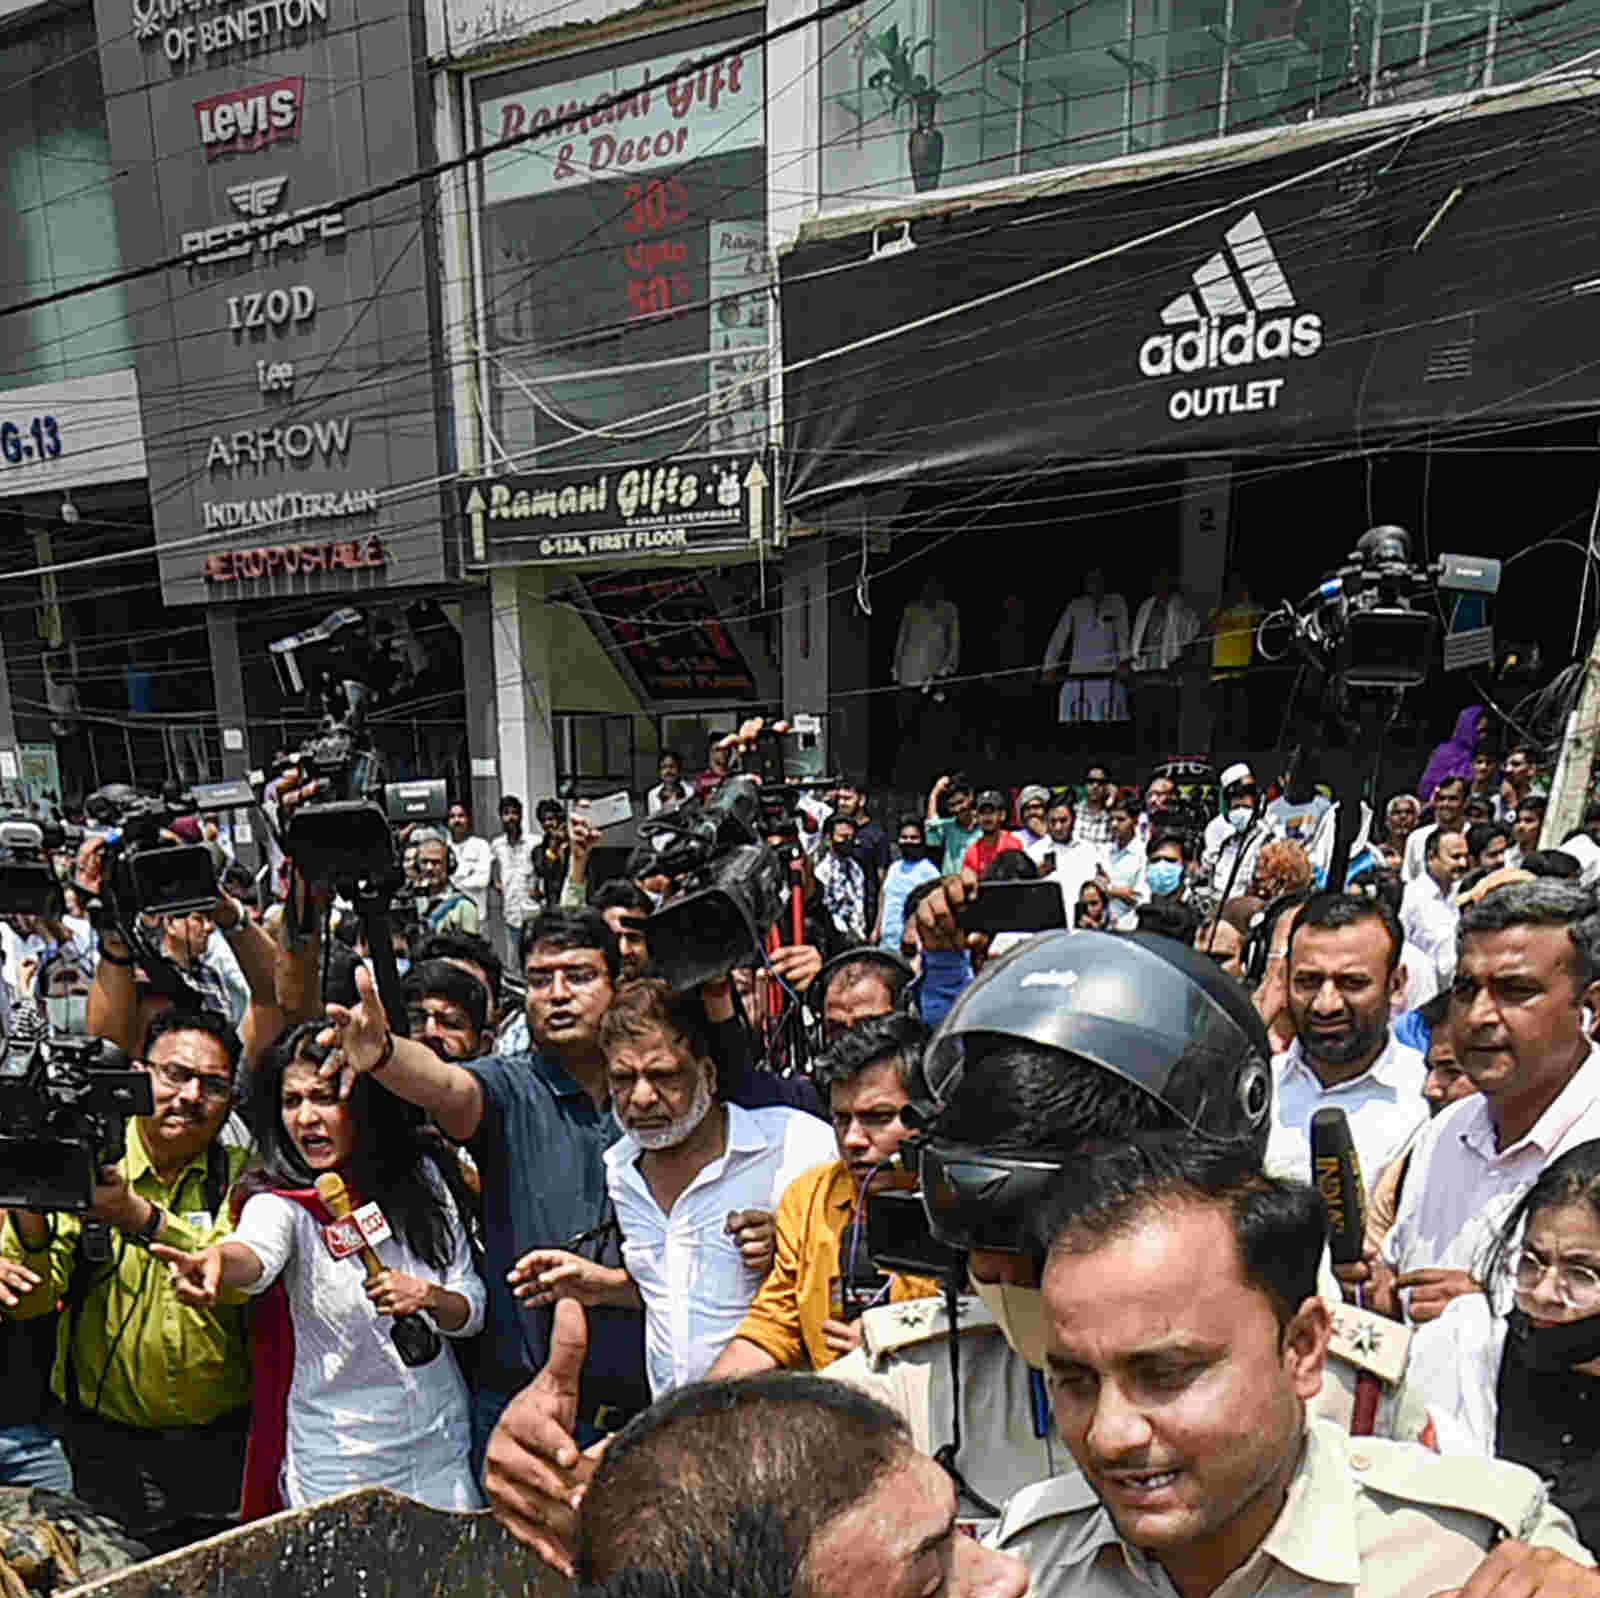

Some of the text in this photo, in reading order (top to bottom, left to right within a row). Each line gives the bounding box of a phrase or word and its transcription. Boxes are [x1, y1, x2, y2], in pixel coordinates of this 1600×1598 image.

[164, 27, 200, 60] OF
[202, 0, 328, 53] BENETTON
[553, 127, 689, 180] & Decor
[227, 286, 315, 328] IZOD
[1139, 309, 1323, 377] adidas
[256, 360, 294, 391] Lee
[1169, 378, 1285, 420] OUTLET
[207, 416, 350, 467] ARROW
[203, 499, 277, 529] INDIAN
[489, 466, 698, 520] Ramani Gifts
[588, 531, 632, 552] FIRST
[635, 527, 688, 549] FLOOR
